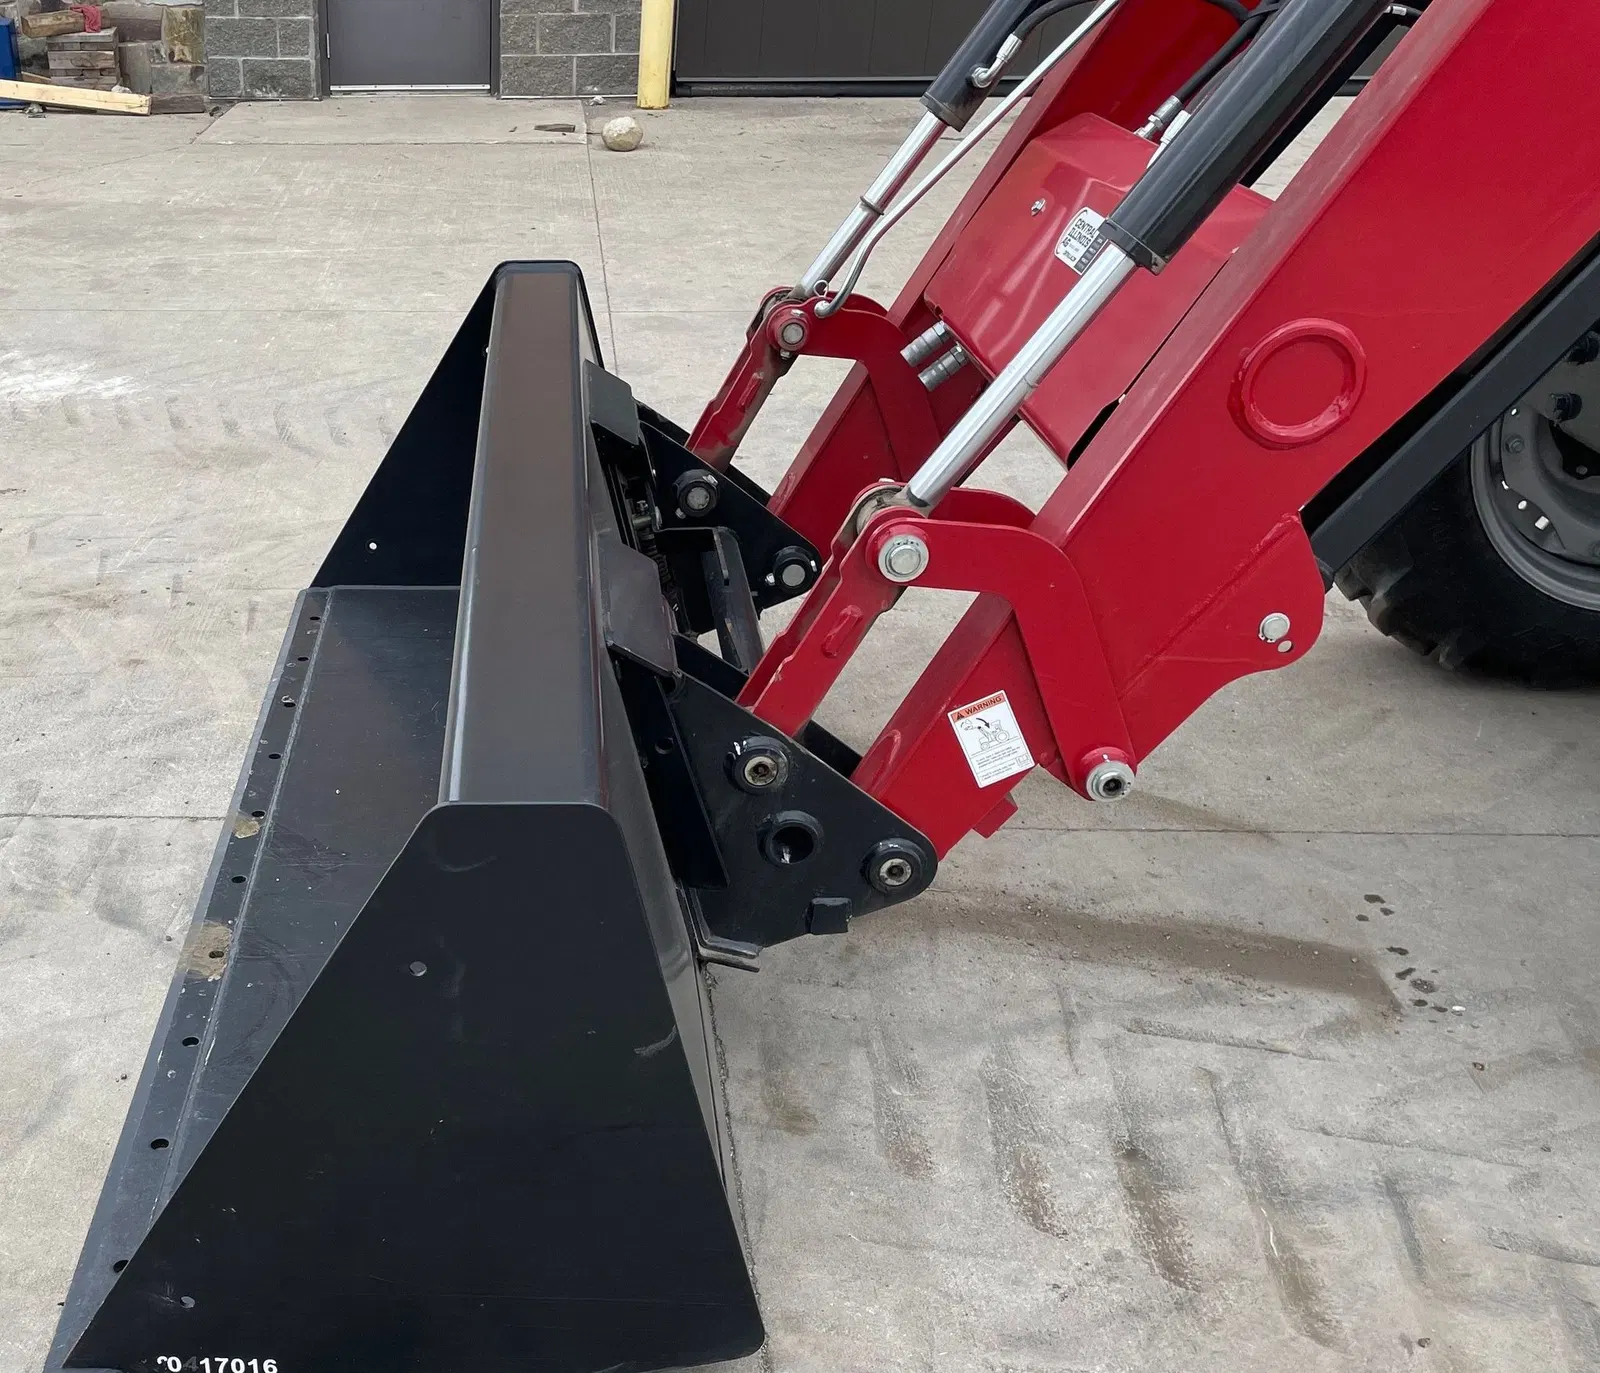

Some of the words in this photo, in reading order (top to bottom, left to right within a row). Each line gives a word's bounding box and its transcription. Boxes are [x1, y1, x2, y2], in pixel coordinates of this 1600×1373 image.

[1068, 227, 1092, 248] ILLINOIS
[1075, 218, 1096, 239] CENTRAL
[964, 696, 1002, 716] WARNING
